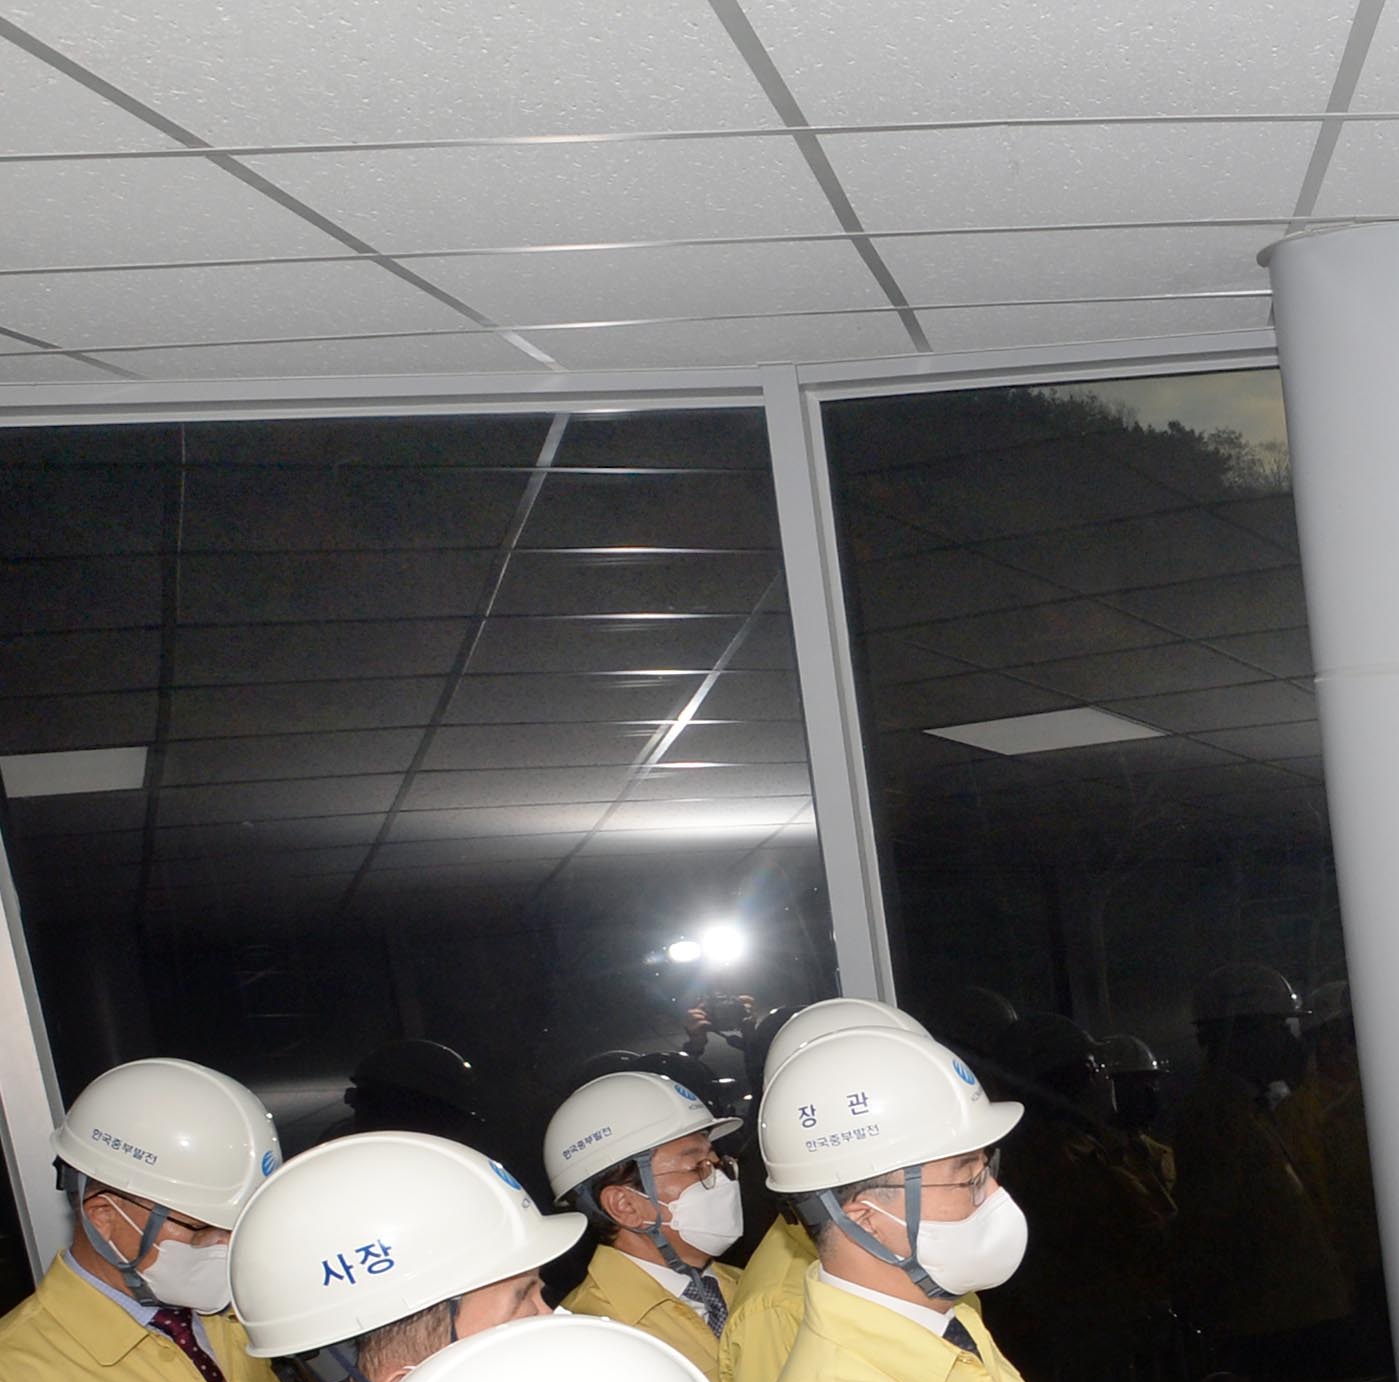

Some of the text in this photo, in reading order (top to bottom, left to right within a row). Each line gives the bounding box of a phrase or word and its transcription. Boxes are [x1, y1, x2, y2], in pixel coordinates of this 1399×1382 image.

[798, 1092, 869, 1128] 장 관
[90, 1128, 158, 1166] 한국중부발전
[562, 1126, 613, 1160] 한국중부발전
[805, 1123, 881, 1153] 한국중부발전
[321, 1239, 396, 1287] 사장
